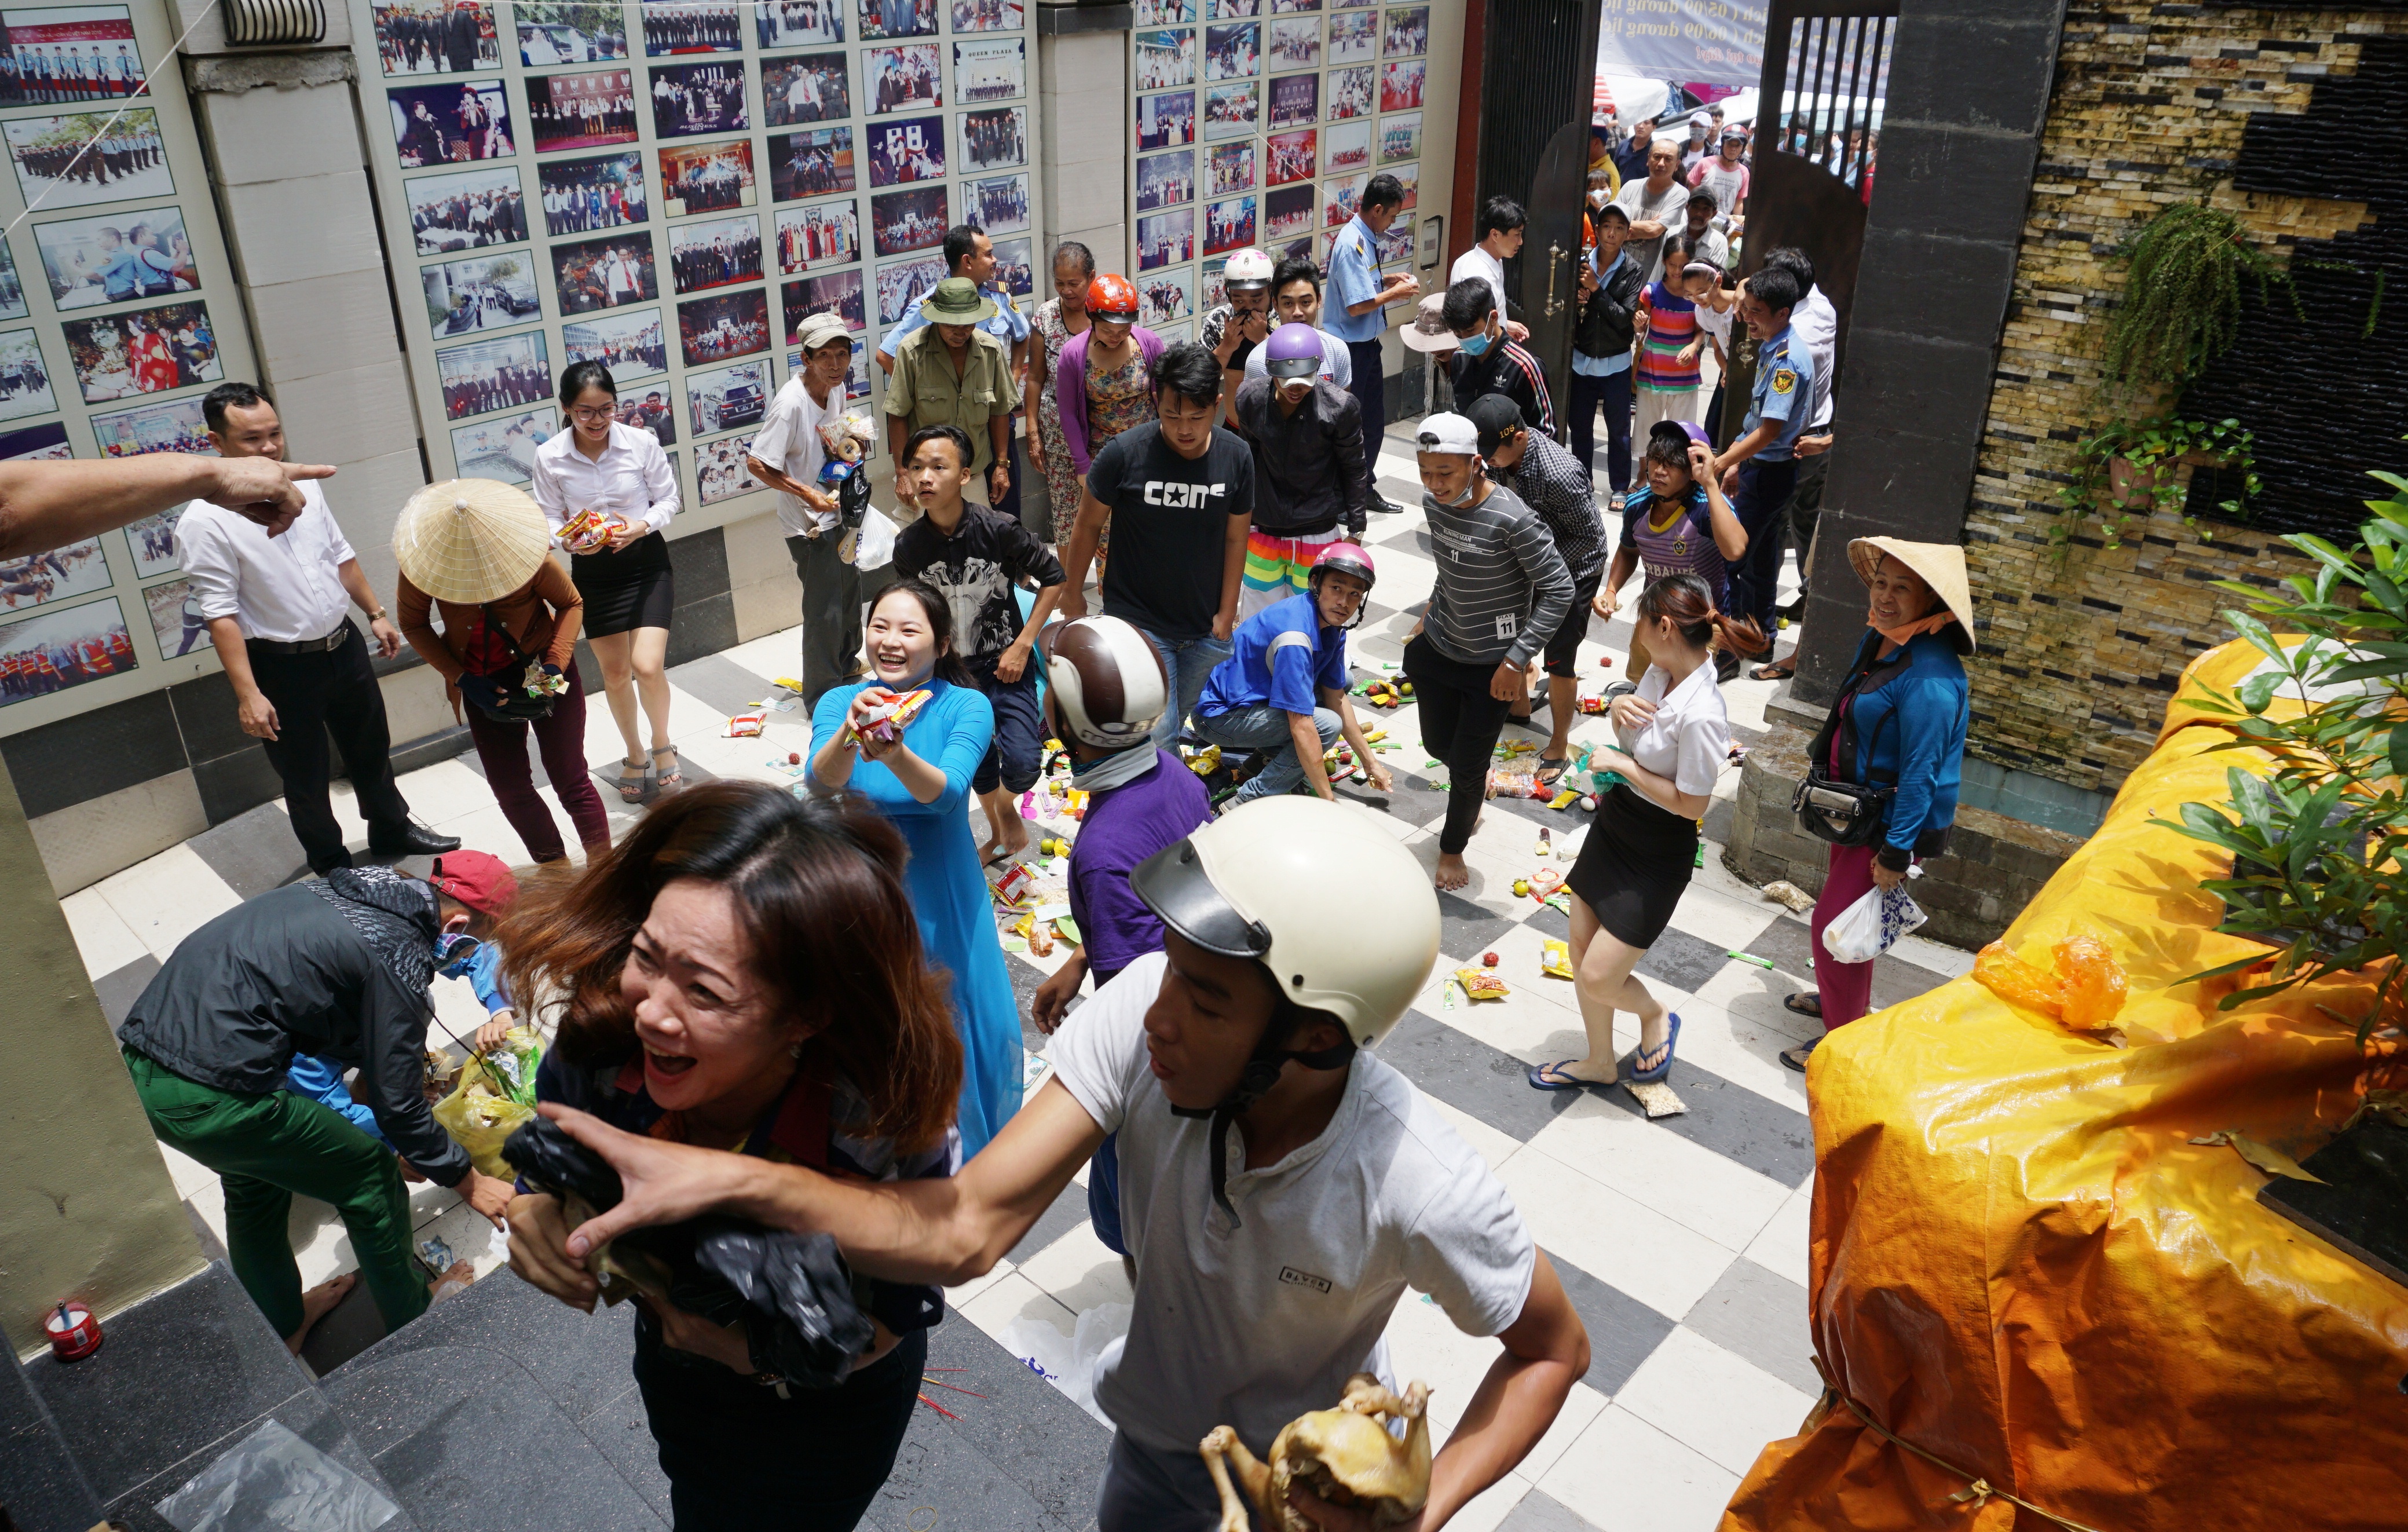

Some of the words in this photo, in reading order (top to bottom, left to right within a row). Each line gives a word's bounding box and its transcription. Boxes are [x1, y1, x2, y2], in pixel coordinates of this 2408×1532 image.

[1499, 424, 1515, 439] 108
[1443, 528, 1459, 539] RUNING
[1459, 535, 1472, 543] MAN
[1450, 549, 1459, 564] 11
[1501, 621, 1512, 634] 11
